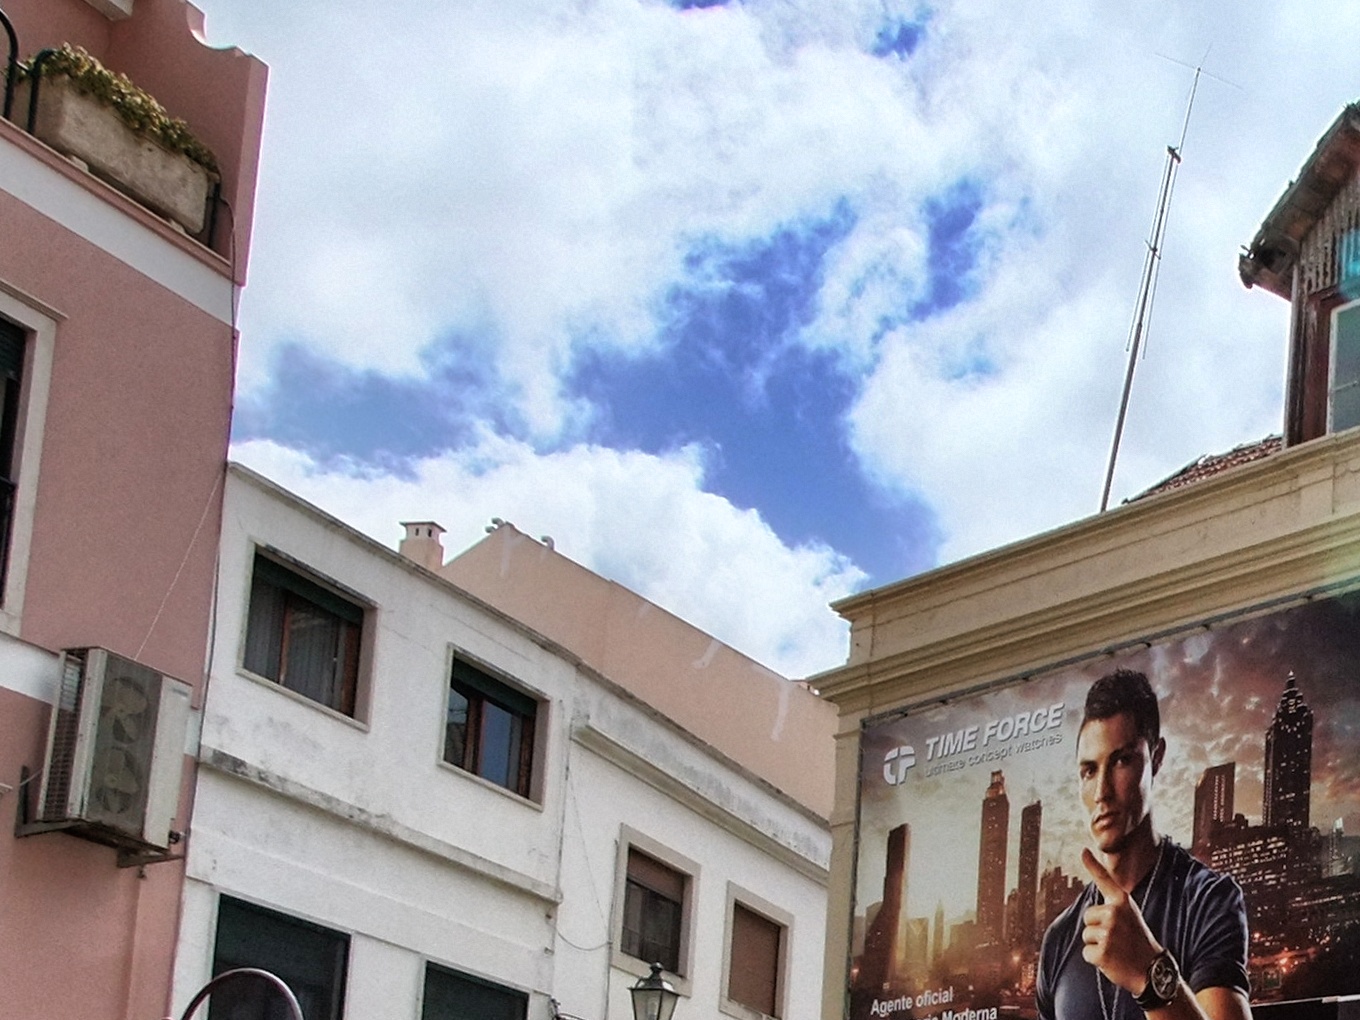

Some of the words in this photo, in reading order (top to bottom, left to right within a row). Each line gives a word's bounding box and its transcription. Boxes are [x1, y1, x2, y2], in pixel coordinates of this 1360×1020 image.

[925, 726, 979, 762] TIME
[983, 702, 1065, 747] FORCE
[925, 759, 965, 778] ultimate
[968, 746, 1011, 769] concept
[1015, 732, 1062, 754] watches
[870, 995, 913, 1017] Agente
[915, 986, 954, 1007] oficial
